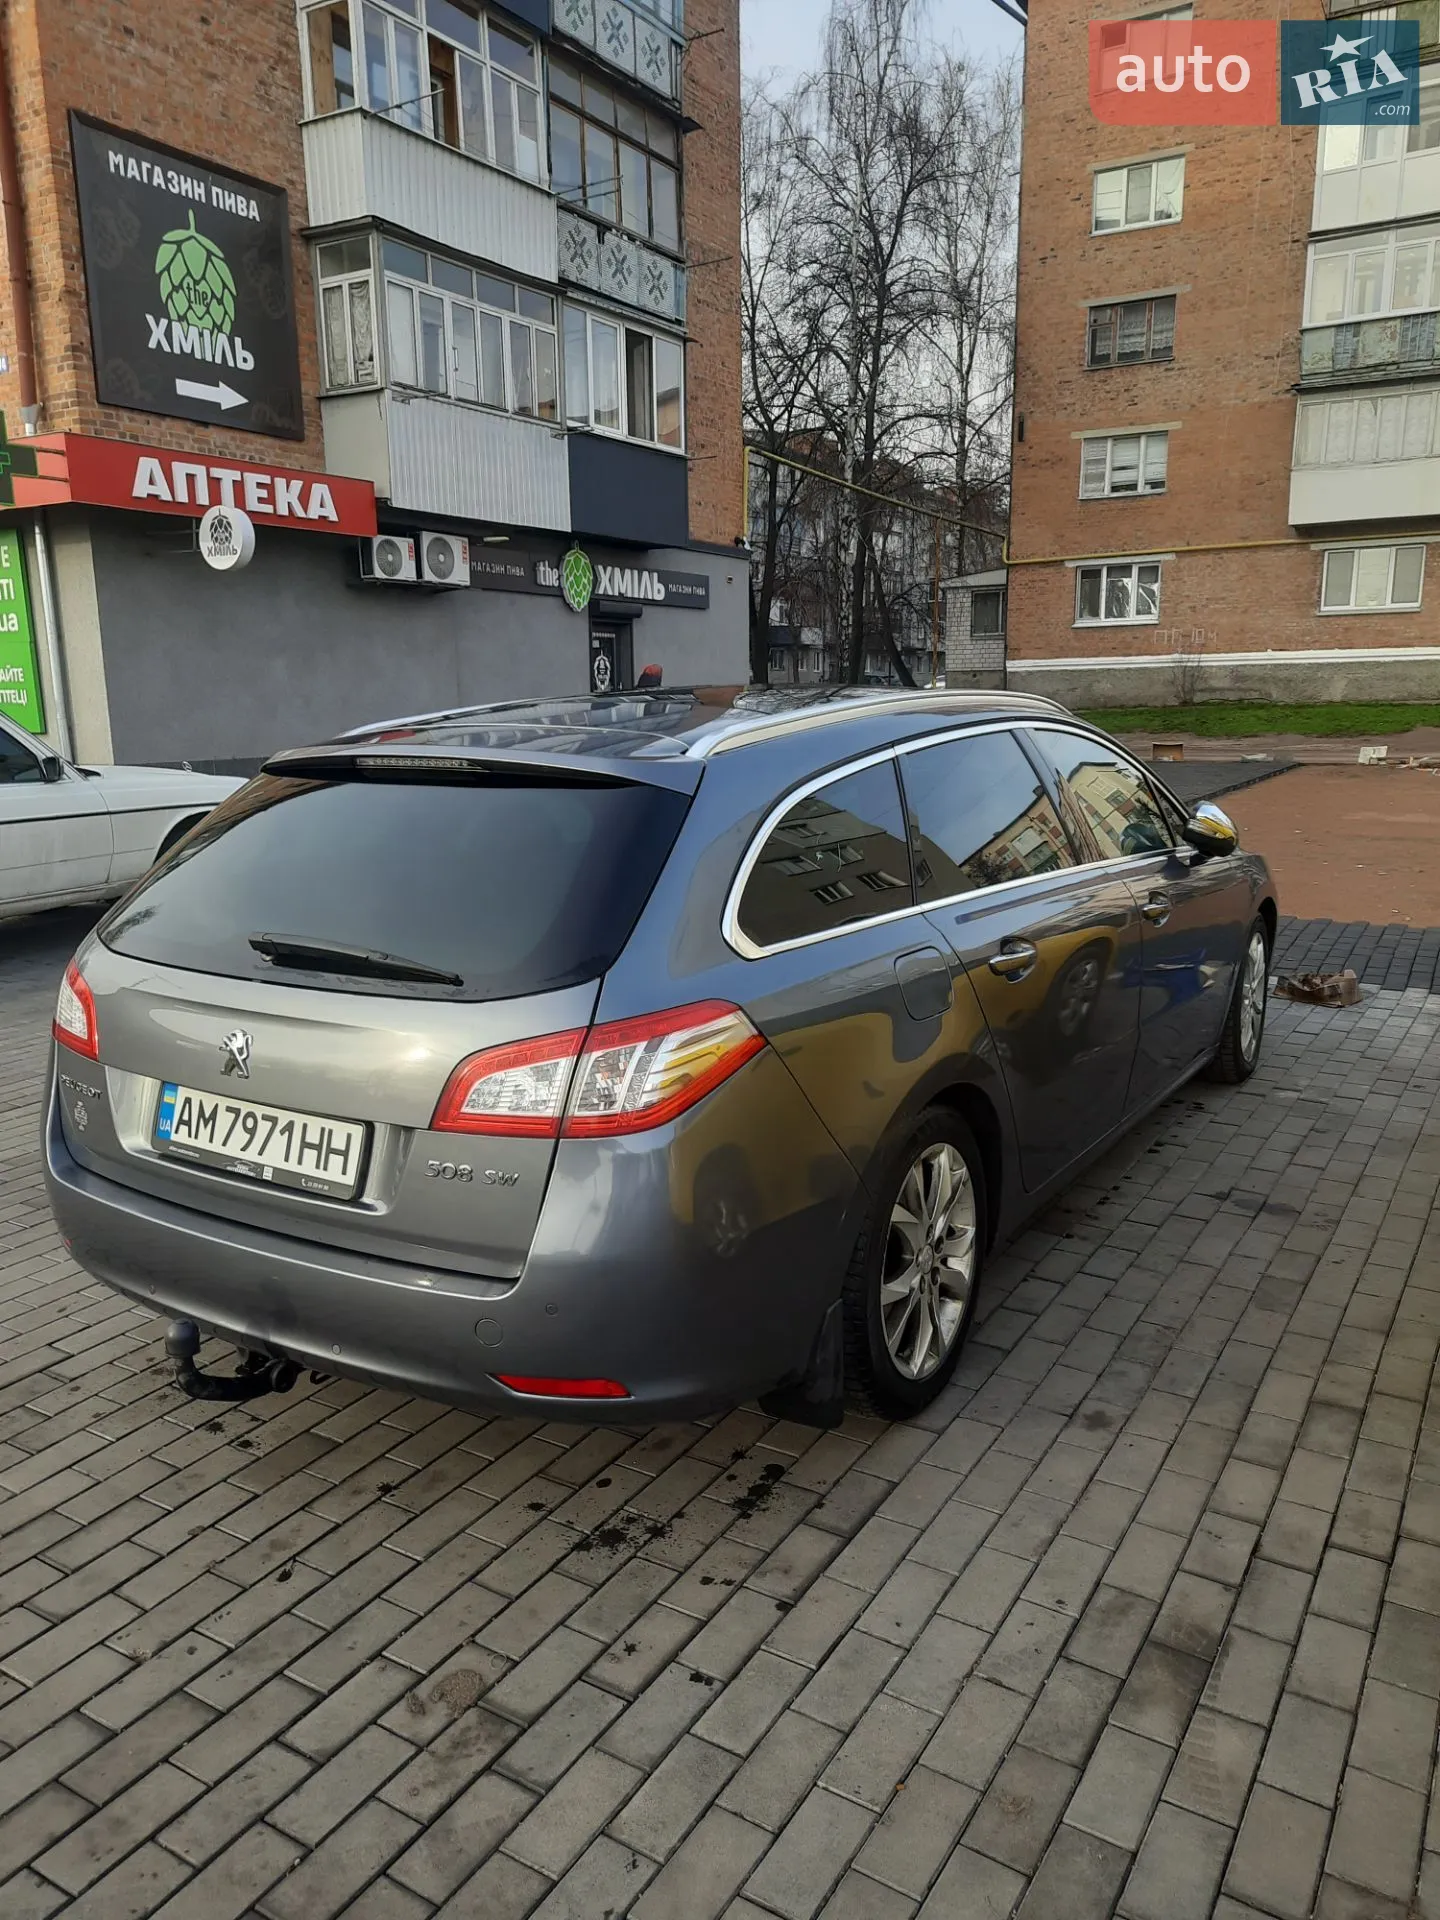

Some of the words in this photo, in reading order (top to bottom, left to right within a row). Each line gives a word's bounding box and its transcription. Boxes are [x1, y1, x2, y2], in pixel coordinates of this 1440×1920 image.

[107, 150, 206, 203] МАГАЗИН
[211, 184, 260, 222] ПИВА
[186, 281, 209, 307] the
[145, 313, 255, 371] ХМІЛЬ
[132, 456, 339, 522] АПТЕКА
[471, 561, 505, 575] МАГАЗИН
[507, 565, 525, 577] ПИВА
[537, 560, 559, 588] the
[597, 564, 665, 600] ХМІЛЬ
[158, 1118, 172, 1132] UA
[424, 1160, 473, 1182] 508
[482, 1169, 520, 1187] SW
